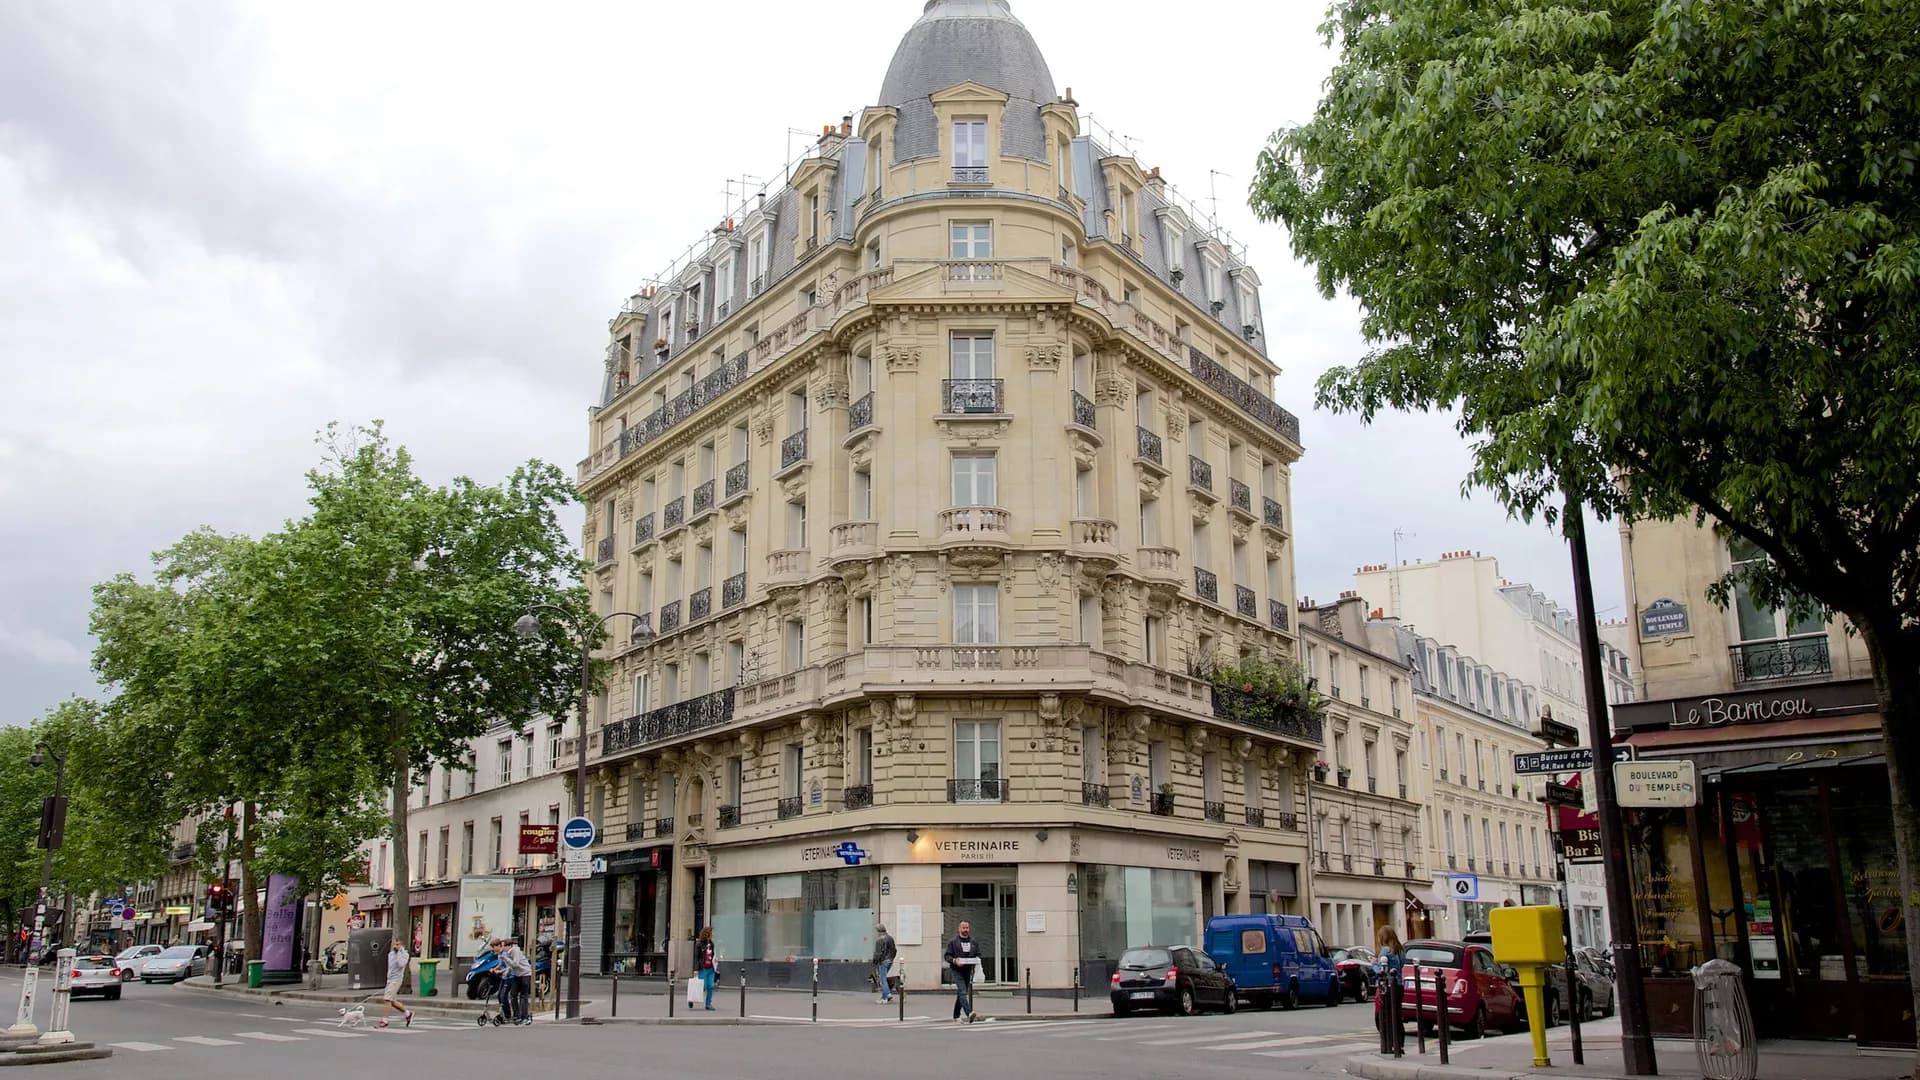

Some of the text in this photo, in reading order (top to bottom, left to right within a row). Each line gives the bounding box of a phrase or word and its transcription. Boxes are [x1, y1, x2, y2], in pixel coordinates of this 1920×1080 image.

[1645, 613, 1684, 624] BOULEVARD
[1658, 621, 1684, 630] TEMPLE
[1669, 698, 1812, 726] Le Barricou
[1540, 750, 1593, 761] Bureau de Po
[1566, 761, 1575, 769] de
[1630, 771, 1678, 780] BOULEVARD
[1629, 783, 1681, 792] DU TEMPLE
[522, 829, 556, 837] rougier
[1577, 829, 1600, 841] Bis
[935, 841, 1019, 851] VETERINAIRE
[1564, 844, 1602, 857] Bar à
[800, 844, 841, 861] VETERINAIR
[1166, 847, 1201, 862] VETERINAIRE
